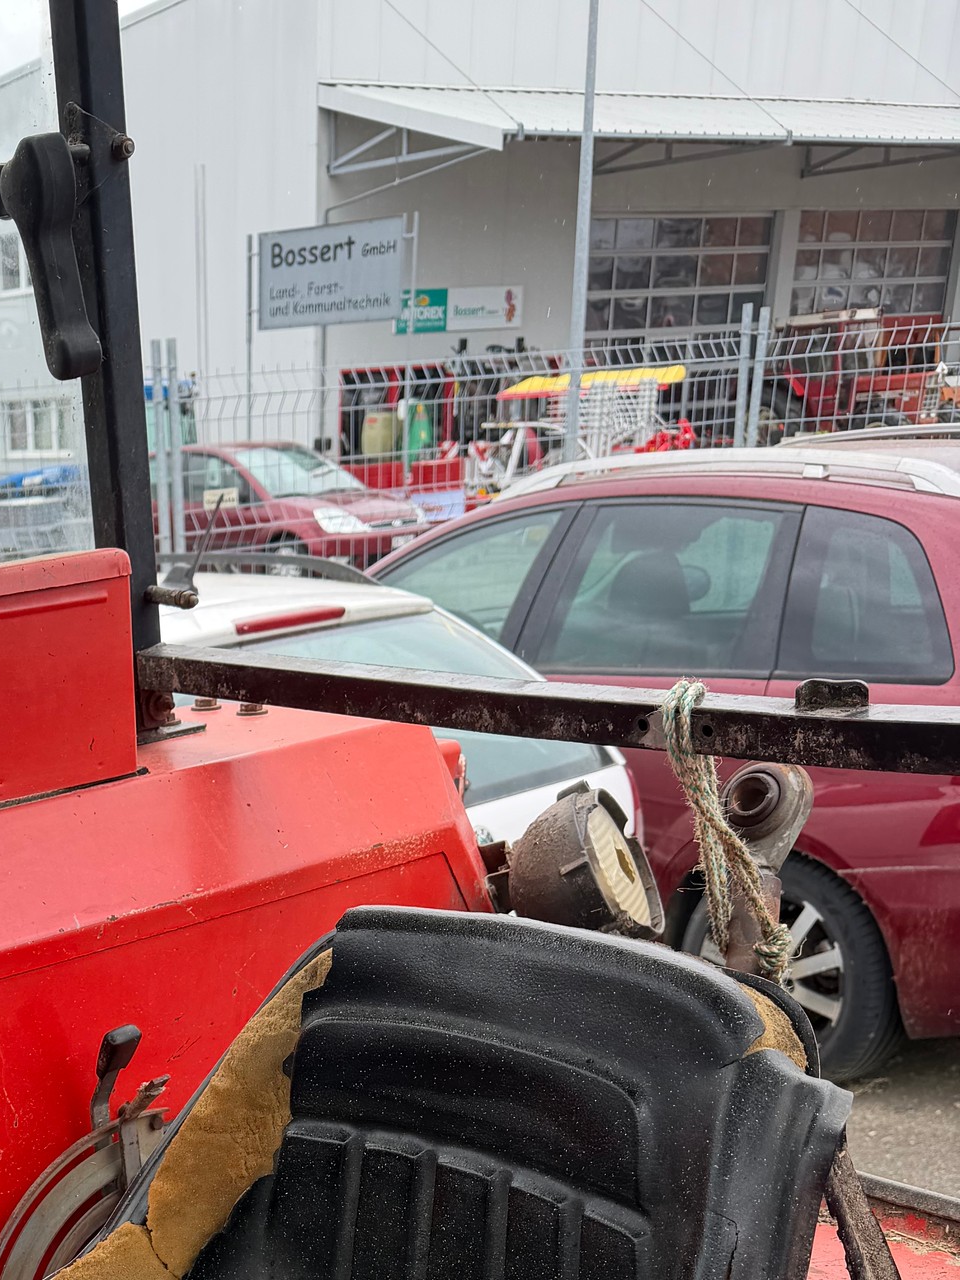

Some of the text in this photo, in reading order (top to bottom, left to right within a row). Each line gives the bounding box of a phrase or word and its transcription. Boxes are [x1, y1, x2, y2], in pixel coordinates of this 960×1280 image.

[271, 235, 398, 268] Bossert GmbH
[307, 281, 344, 298] Forst-
[269, 292, 391, 318] und Kommunaltechnik
[453, 304, 485, 317] Bossert
